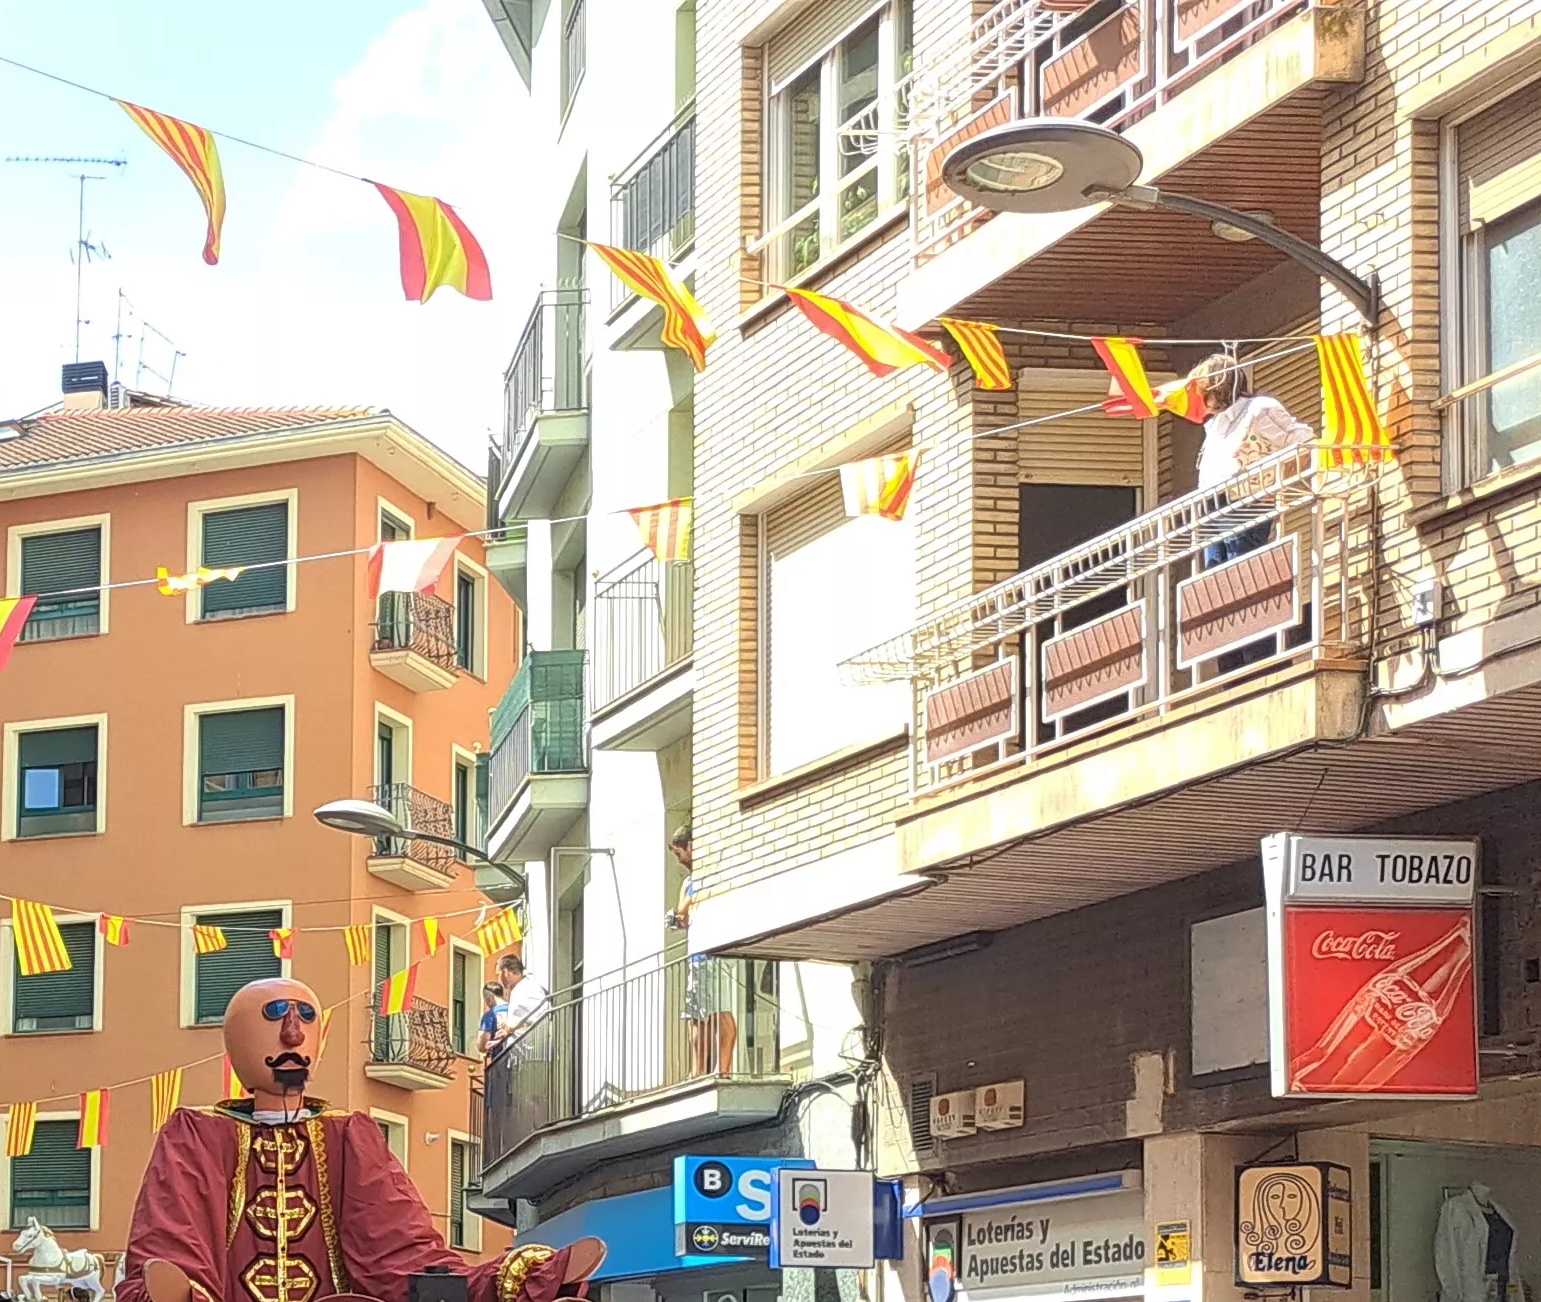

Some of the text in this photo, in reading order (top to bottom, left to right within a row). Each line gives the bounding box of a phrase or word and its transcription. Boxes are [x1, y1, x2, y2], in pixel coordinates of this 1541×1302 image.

[1301, 853, 1472, 885] BAR TOBAZO
[703, 1169, 723, 1191] B
[967, 1214, 1051, 1247] Loterías y
[793, 1239, 853, 1252] Apuestas del
[793, 1250, 826, 1260] Estado
[966, 1233, 1146, 1284] Apuestas del Estado
[1248, 1252, 1317, 1276] Elena
